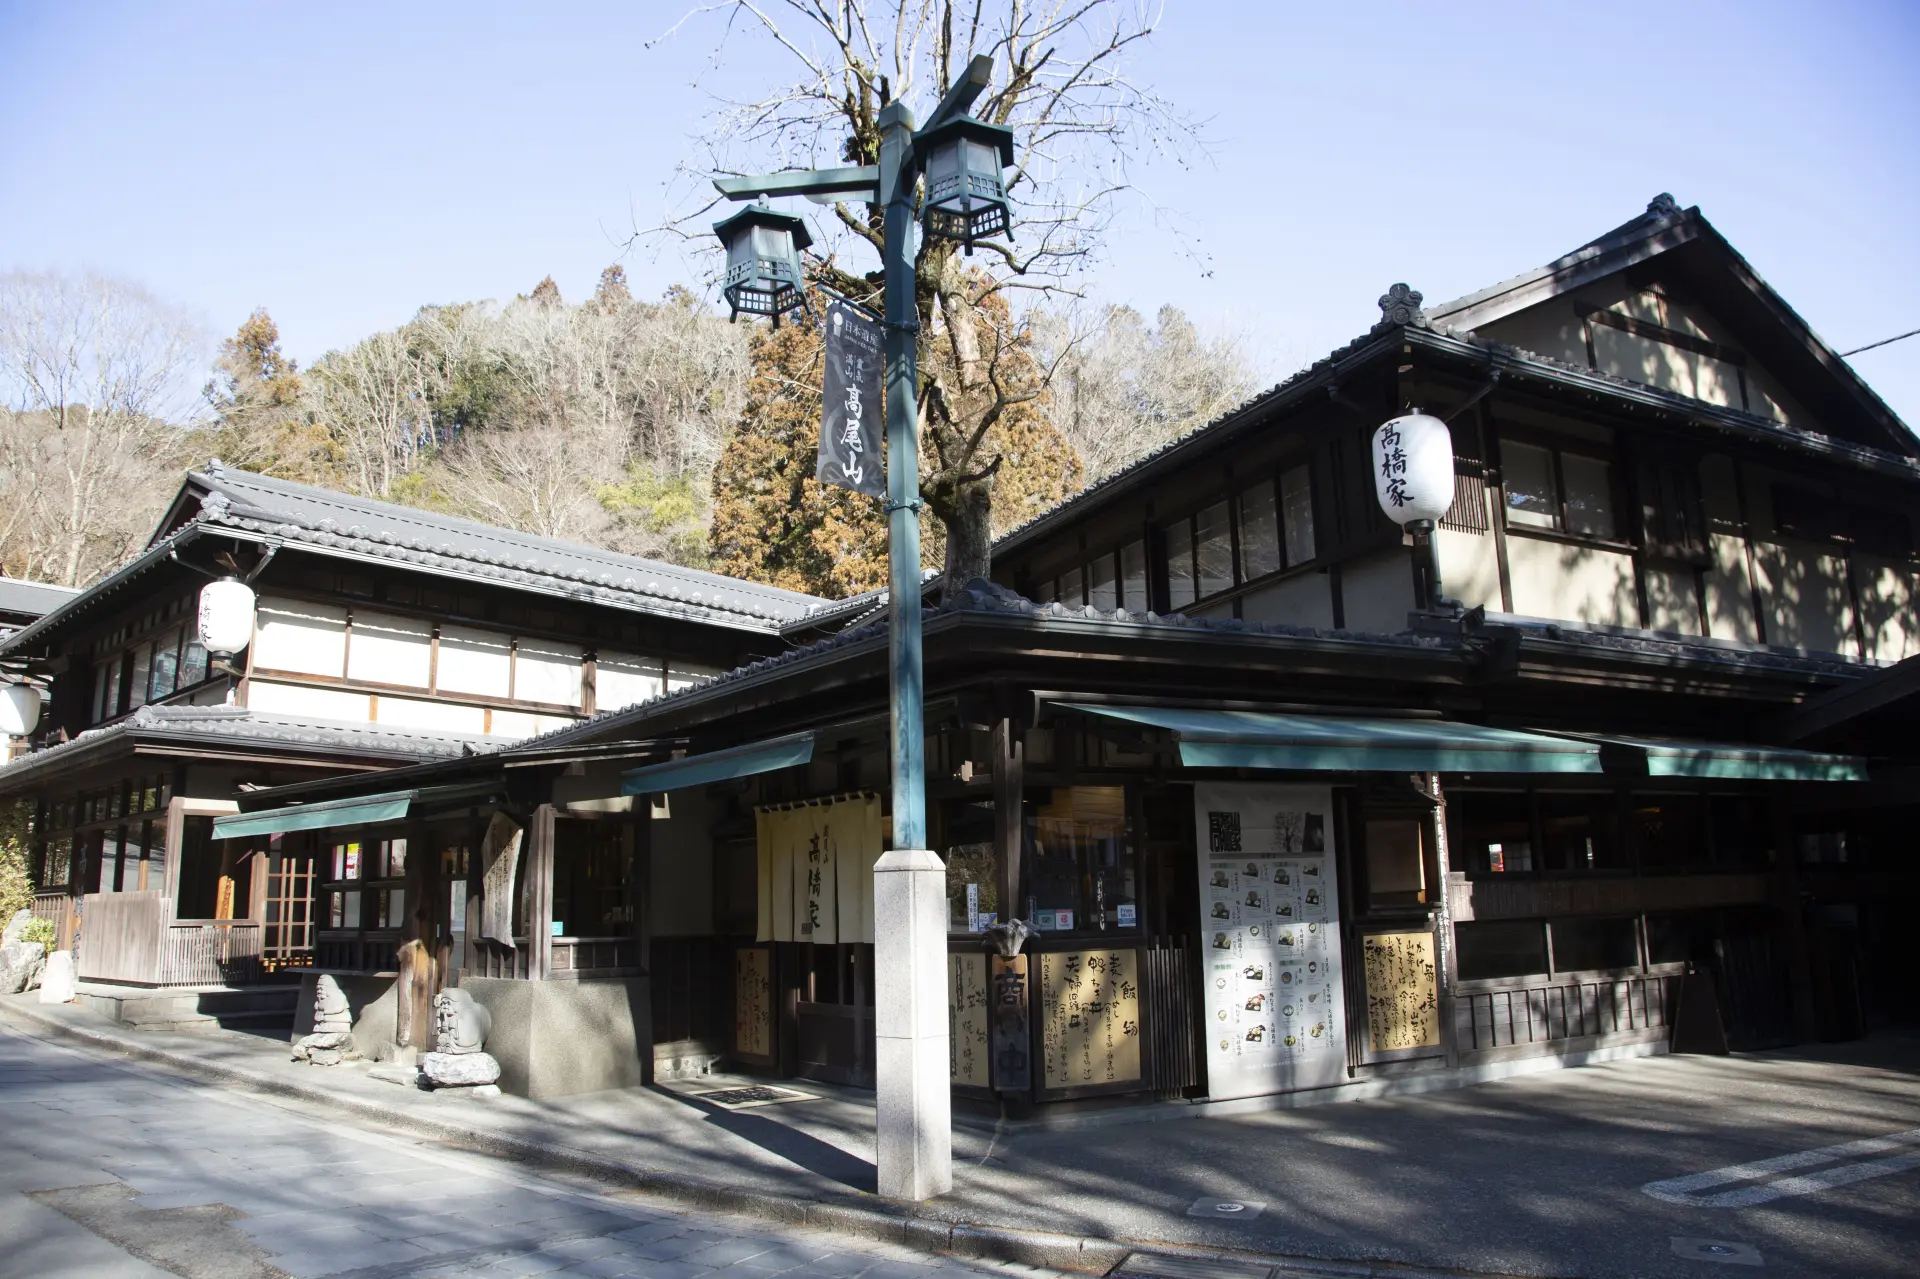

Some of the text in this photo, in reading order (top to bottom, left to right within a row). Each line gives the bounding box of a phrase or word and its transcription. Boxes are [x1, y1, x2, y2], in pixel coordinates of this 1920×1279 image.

[845, 320, 879, 347] 日本遺産
[845, 353, 853, 378] 満山
[841, 383, 863, 484] 高尾山
[1064, 955, 1083, 1030] 天婦羅丼
[1088, 956, 1107, 1018] 鴨ねぎ丼
[1109, 953, 1122, 1018] 麦とろめし
[1406, 939, 1418, 989] 山菜そば
[1423, 963, 1436, 1010] 蕎麦
[994, 965, 1027, 1084] 商い中
[1120, 980, 1138, 1037] 飯物
